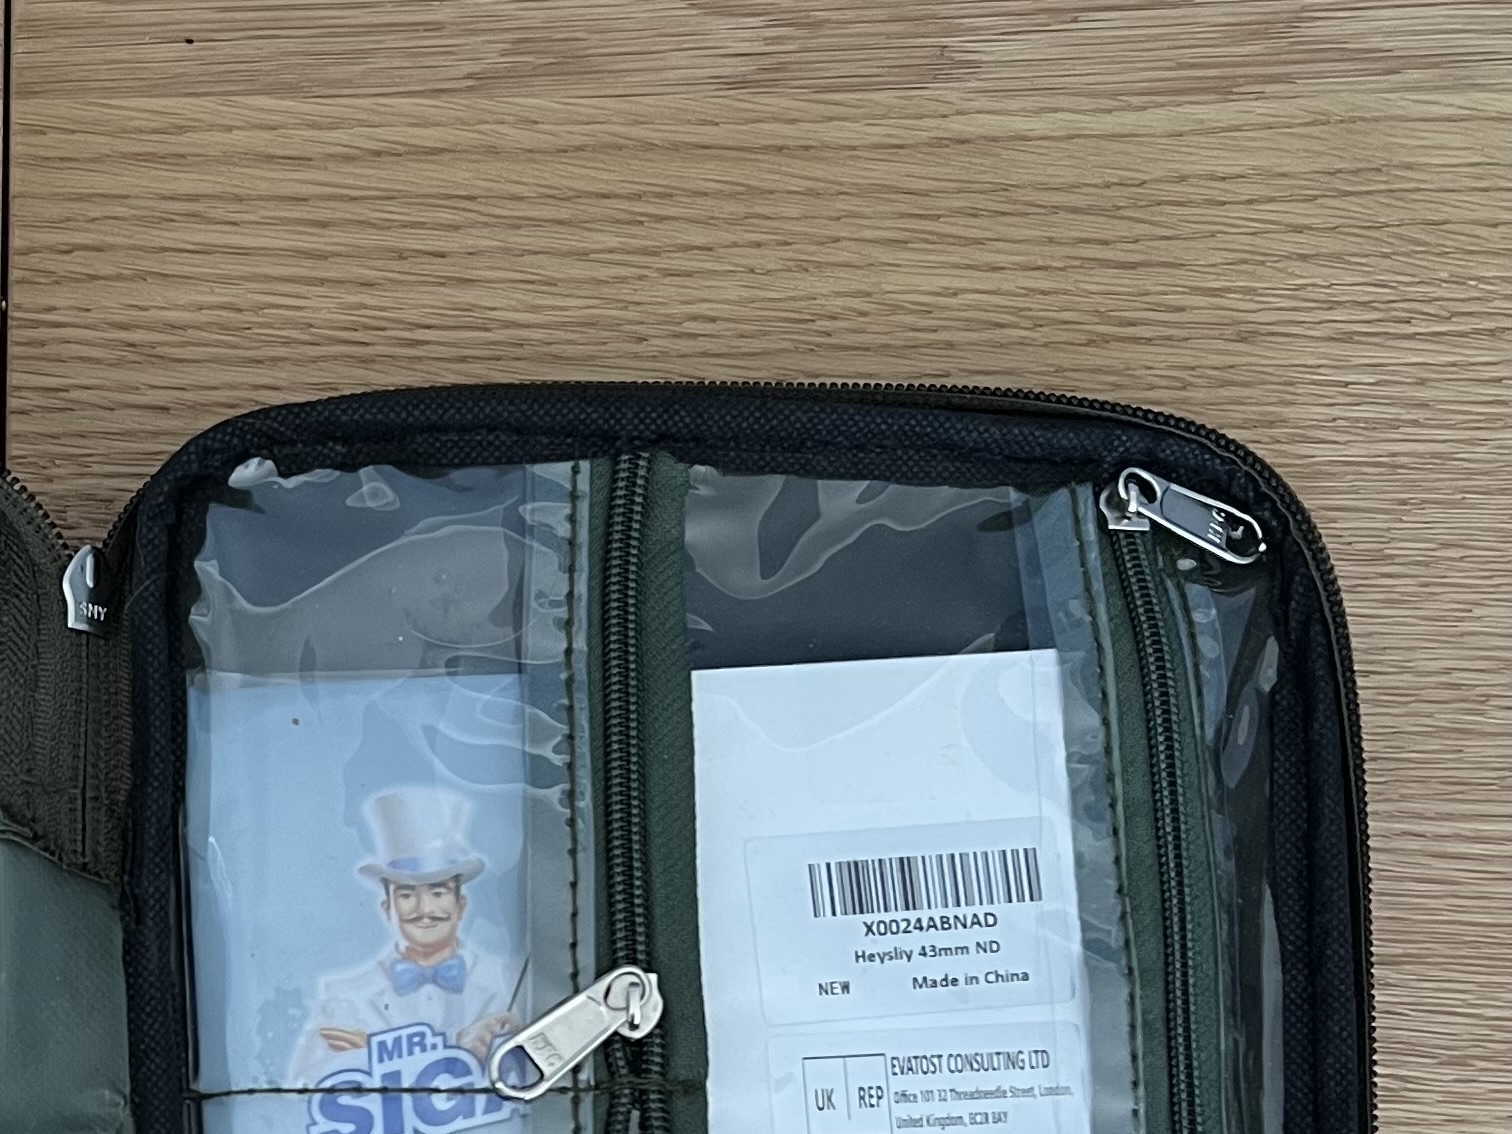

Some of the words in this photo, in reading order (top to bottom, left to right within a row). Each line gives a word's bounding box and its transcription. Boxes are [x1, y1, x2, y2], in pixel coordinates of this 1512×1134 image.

[863, 911, 999, 937] X0024ABNAD
[854, 946, 914, 965] Heysliy
[918, 942, 970, 959] 43mm
[975, 939, 1001, 955] ND
[817, 980, 851, 997] NEW
[912, 972, 960, 990] Made
[964, 971, 980, 986] in
[984, 969, 1030, 985] China
[376, 1031, 438, 1064] MR.
[890, 1054, 944, 1076] EVATOST
[946, 1050, 1026, 1074] CONSULTING
[1028, 1049, 1051, 1070] LTD
[813, 1087, 837, 1112] UK
[857, 1085, 885, 1110] REP
